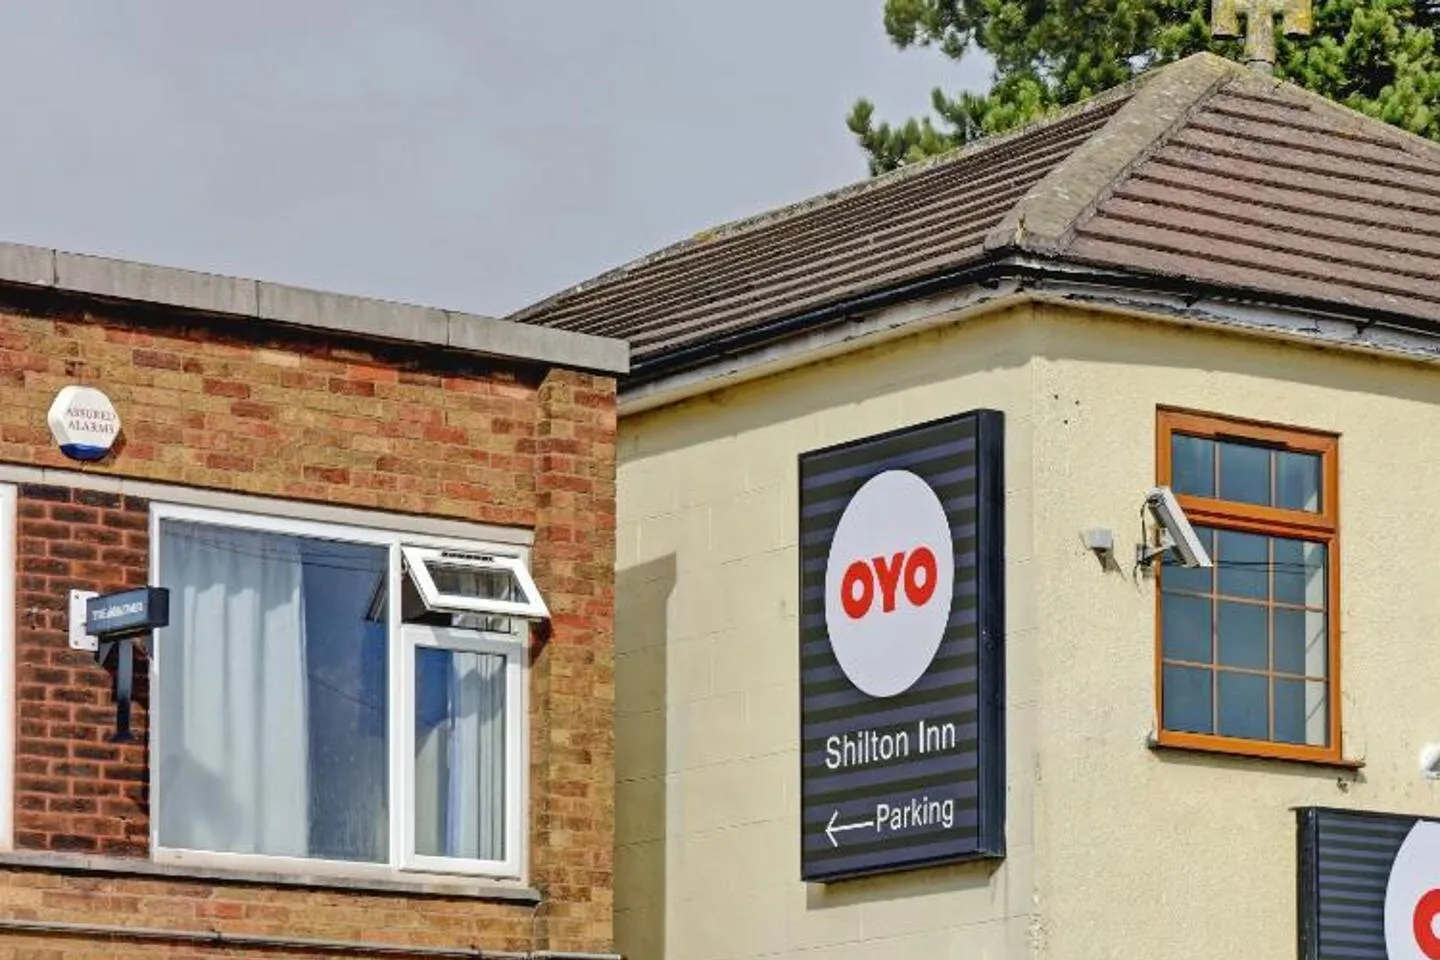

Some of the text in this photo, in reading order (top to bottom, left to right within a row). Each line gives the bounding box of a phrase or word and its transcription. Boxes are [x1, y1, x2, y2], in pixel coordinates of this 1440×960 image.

[841, 547, 938, 619] OYO
[825, 720, 956, 769] Shilton Inn
[876, 796, 953, 832] Parking
